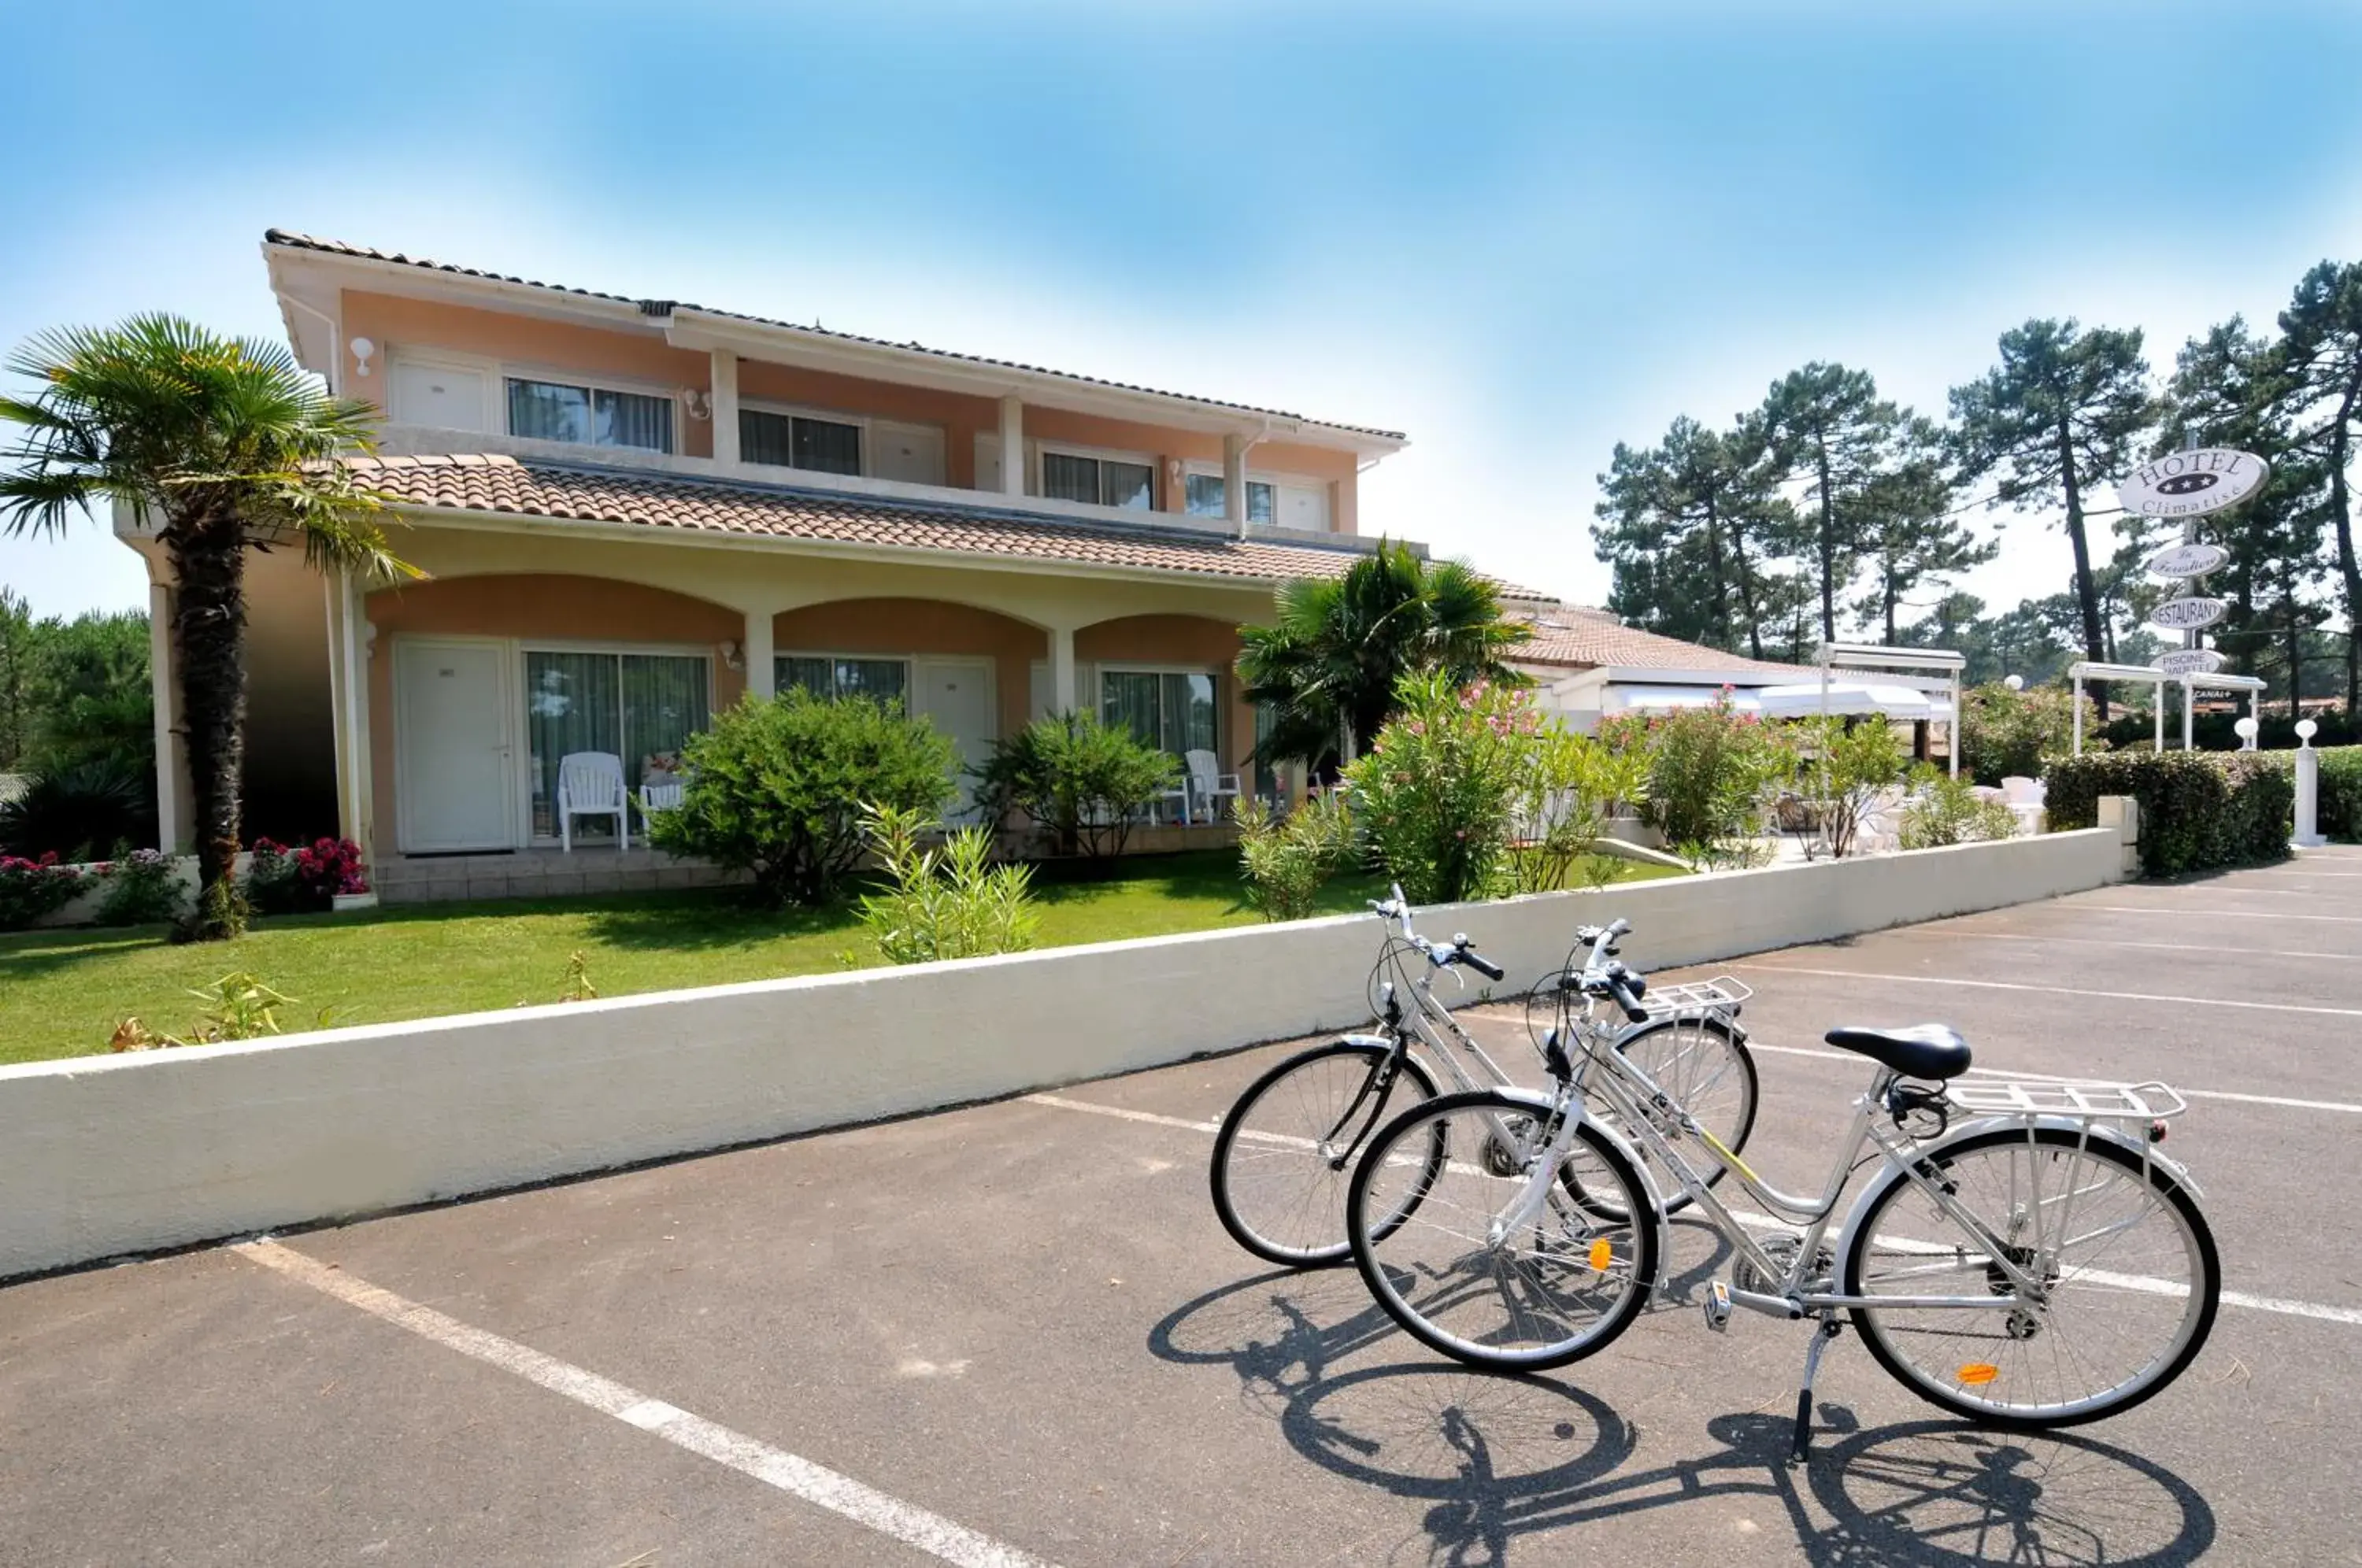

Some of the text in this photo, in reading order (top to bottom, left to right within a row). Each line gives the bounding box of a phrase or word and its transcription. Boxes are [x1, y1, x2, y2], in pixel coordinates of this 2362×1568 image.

[2139, 453, 2244, 488] HOTEL
[2152, 601, 2218, 626] RESTAURANT
[2163, 654, 2205, 666] PISCINE
